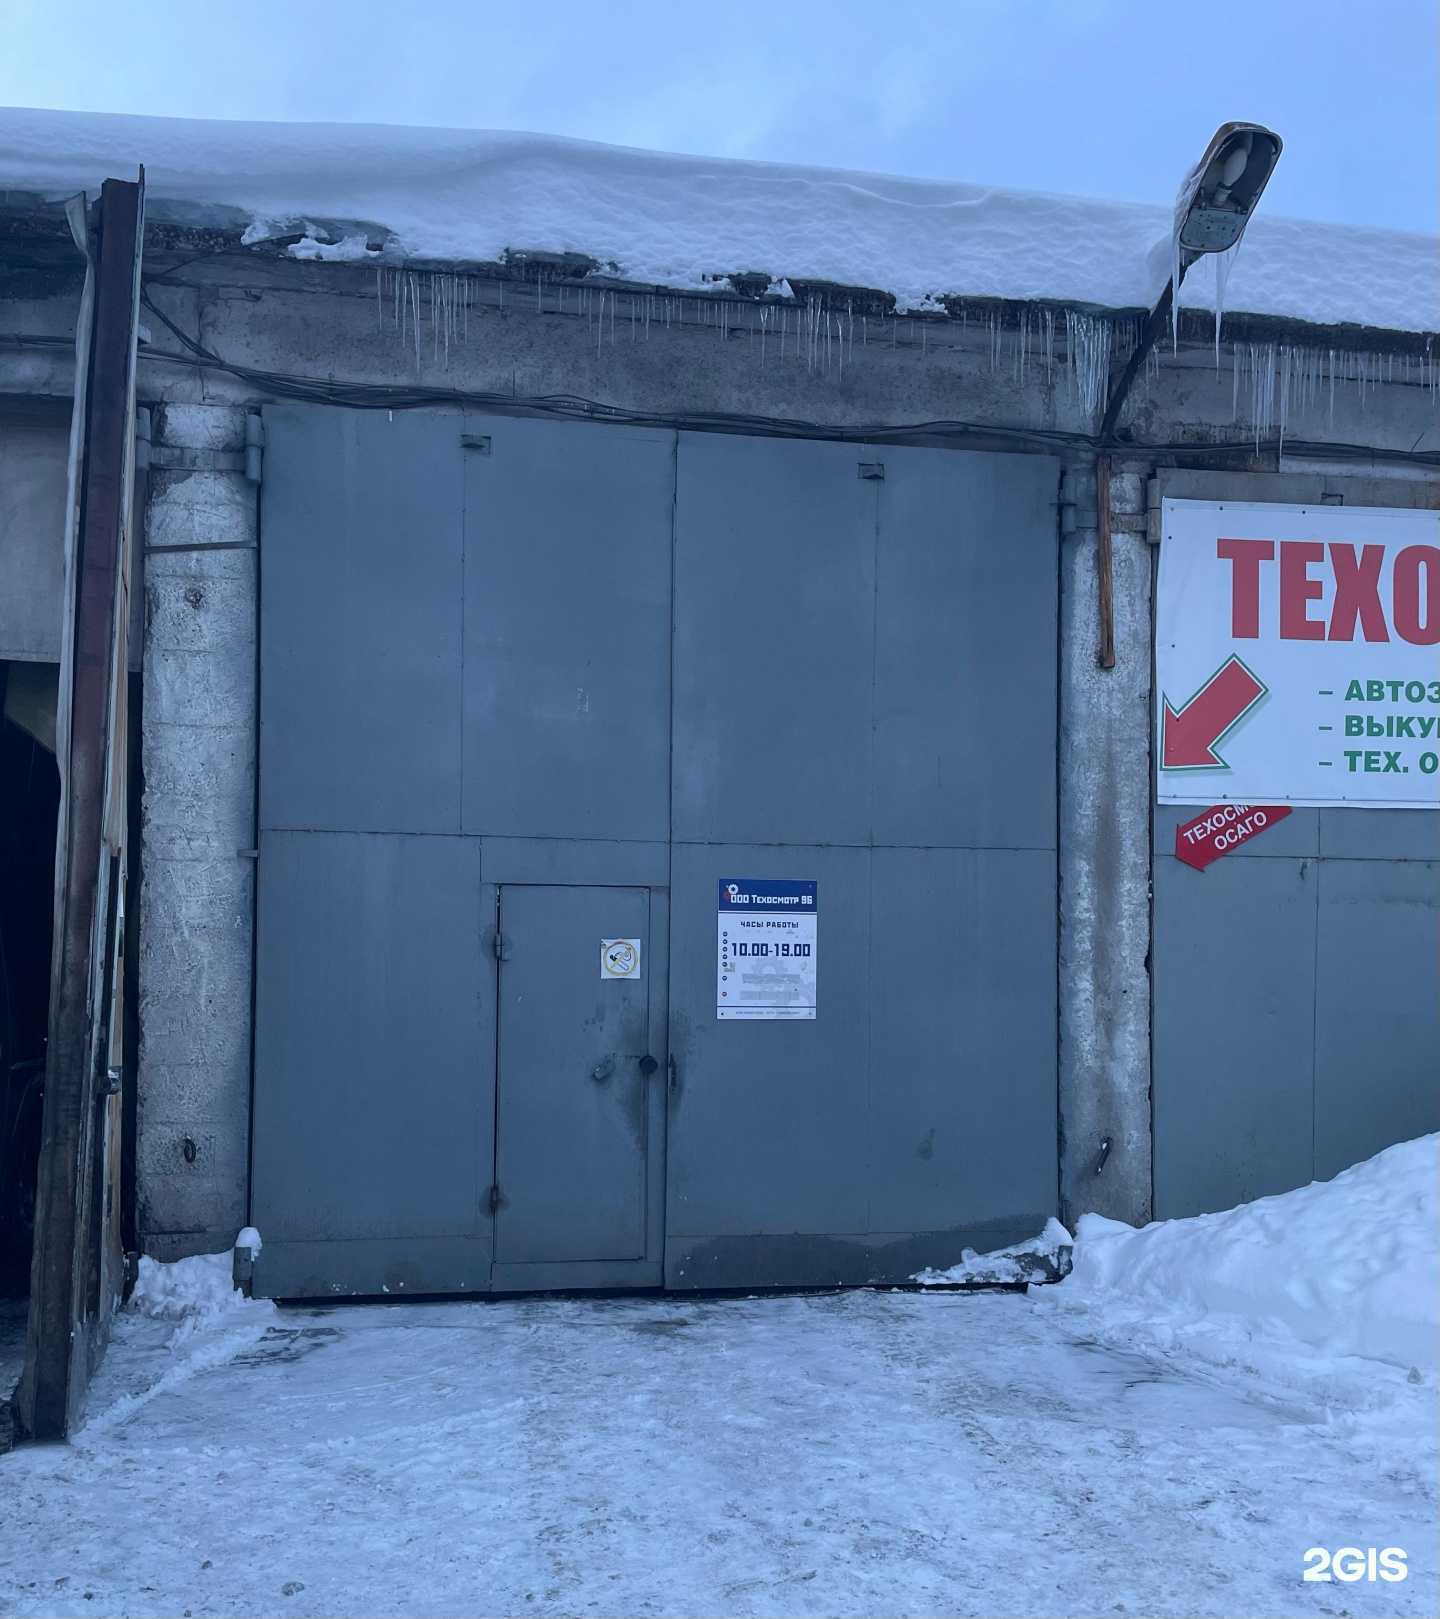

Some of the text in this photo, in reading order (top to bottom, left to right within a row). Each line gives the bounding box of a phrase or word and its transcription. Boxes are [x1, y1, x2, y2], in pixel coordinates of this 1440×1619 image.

[1344, 679, 1440, 703] АВТОЗ
[1344, 714, 1440, 739] ВЫКУ
[1344, 750, 1409, 773] ТЕХ.
[1183, 805, 1256, 844] ТЕХОСМ
[1214, 811, 1267, 850] ОСАГО
[730, 894, 749, 904] ООО
[766, 921, 799, 929] РАБОТЫ
[731, 943, 811, 957] 10.00-19.00
